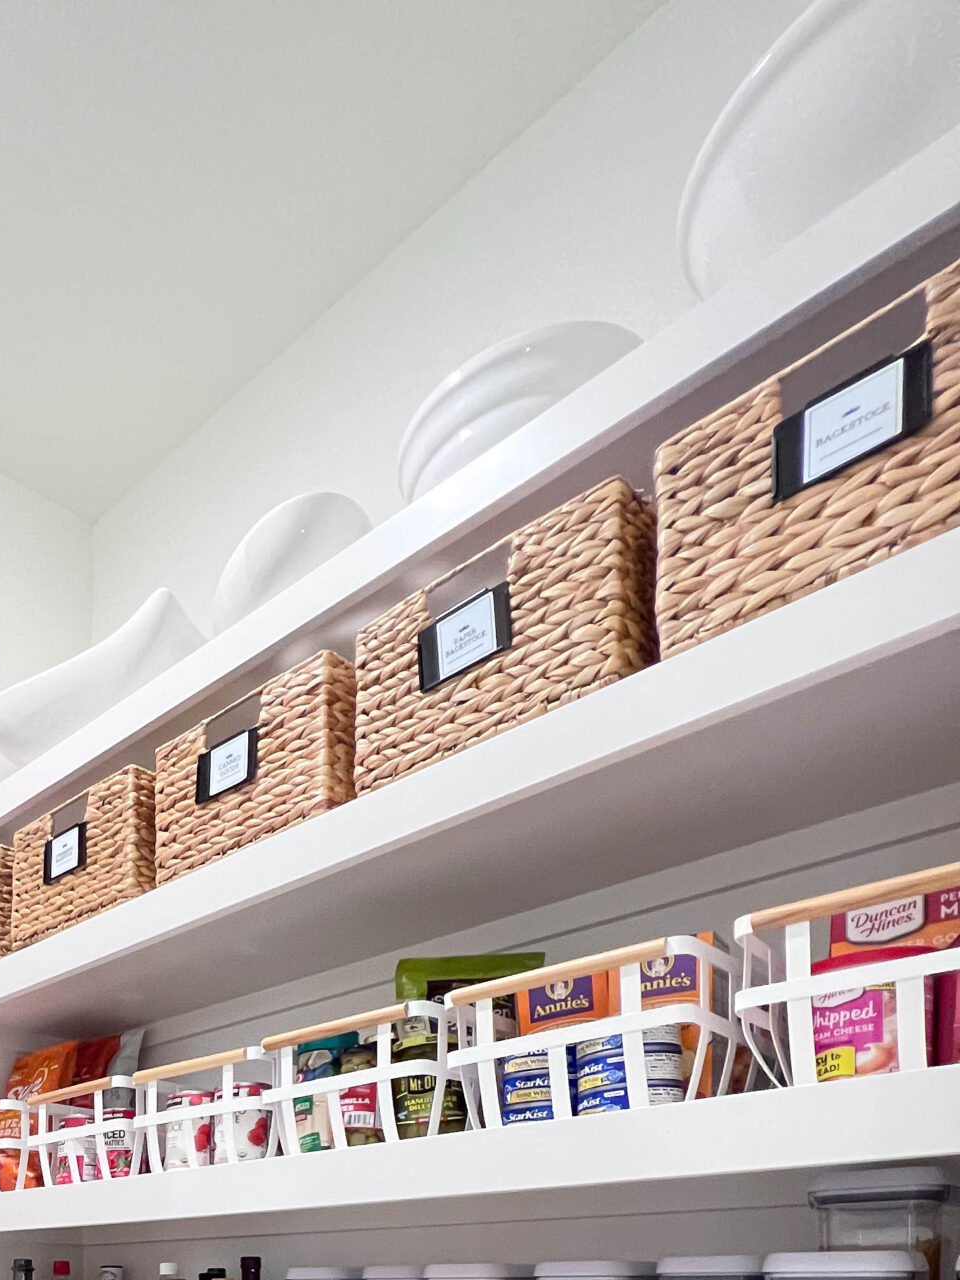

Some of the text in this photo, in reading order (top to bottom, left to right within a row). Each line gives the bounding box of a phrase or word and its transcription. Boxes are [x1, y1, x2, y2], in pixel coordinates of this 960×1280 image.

[851, 899, 917, 929] Duncan
[860, 912, 915, 938] Hines
[641, 973, 691, 992] nnie's
[534, 995, 589, 1019] Annie's
[833, 1023, 875, 1037] CHEESE
[509, 1109, 548, 1121] StarKist
